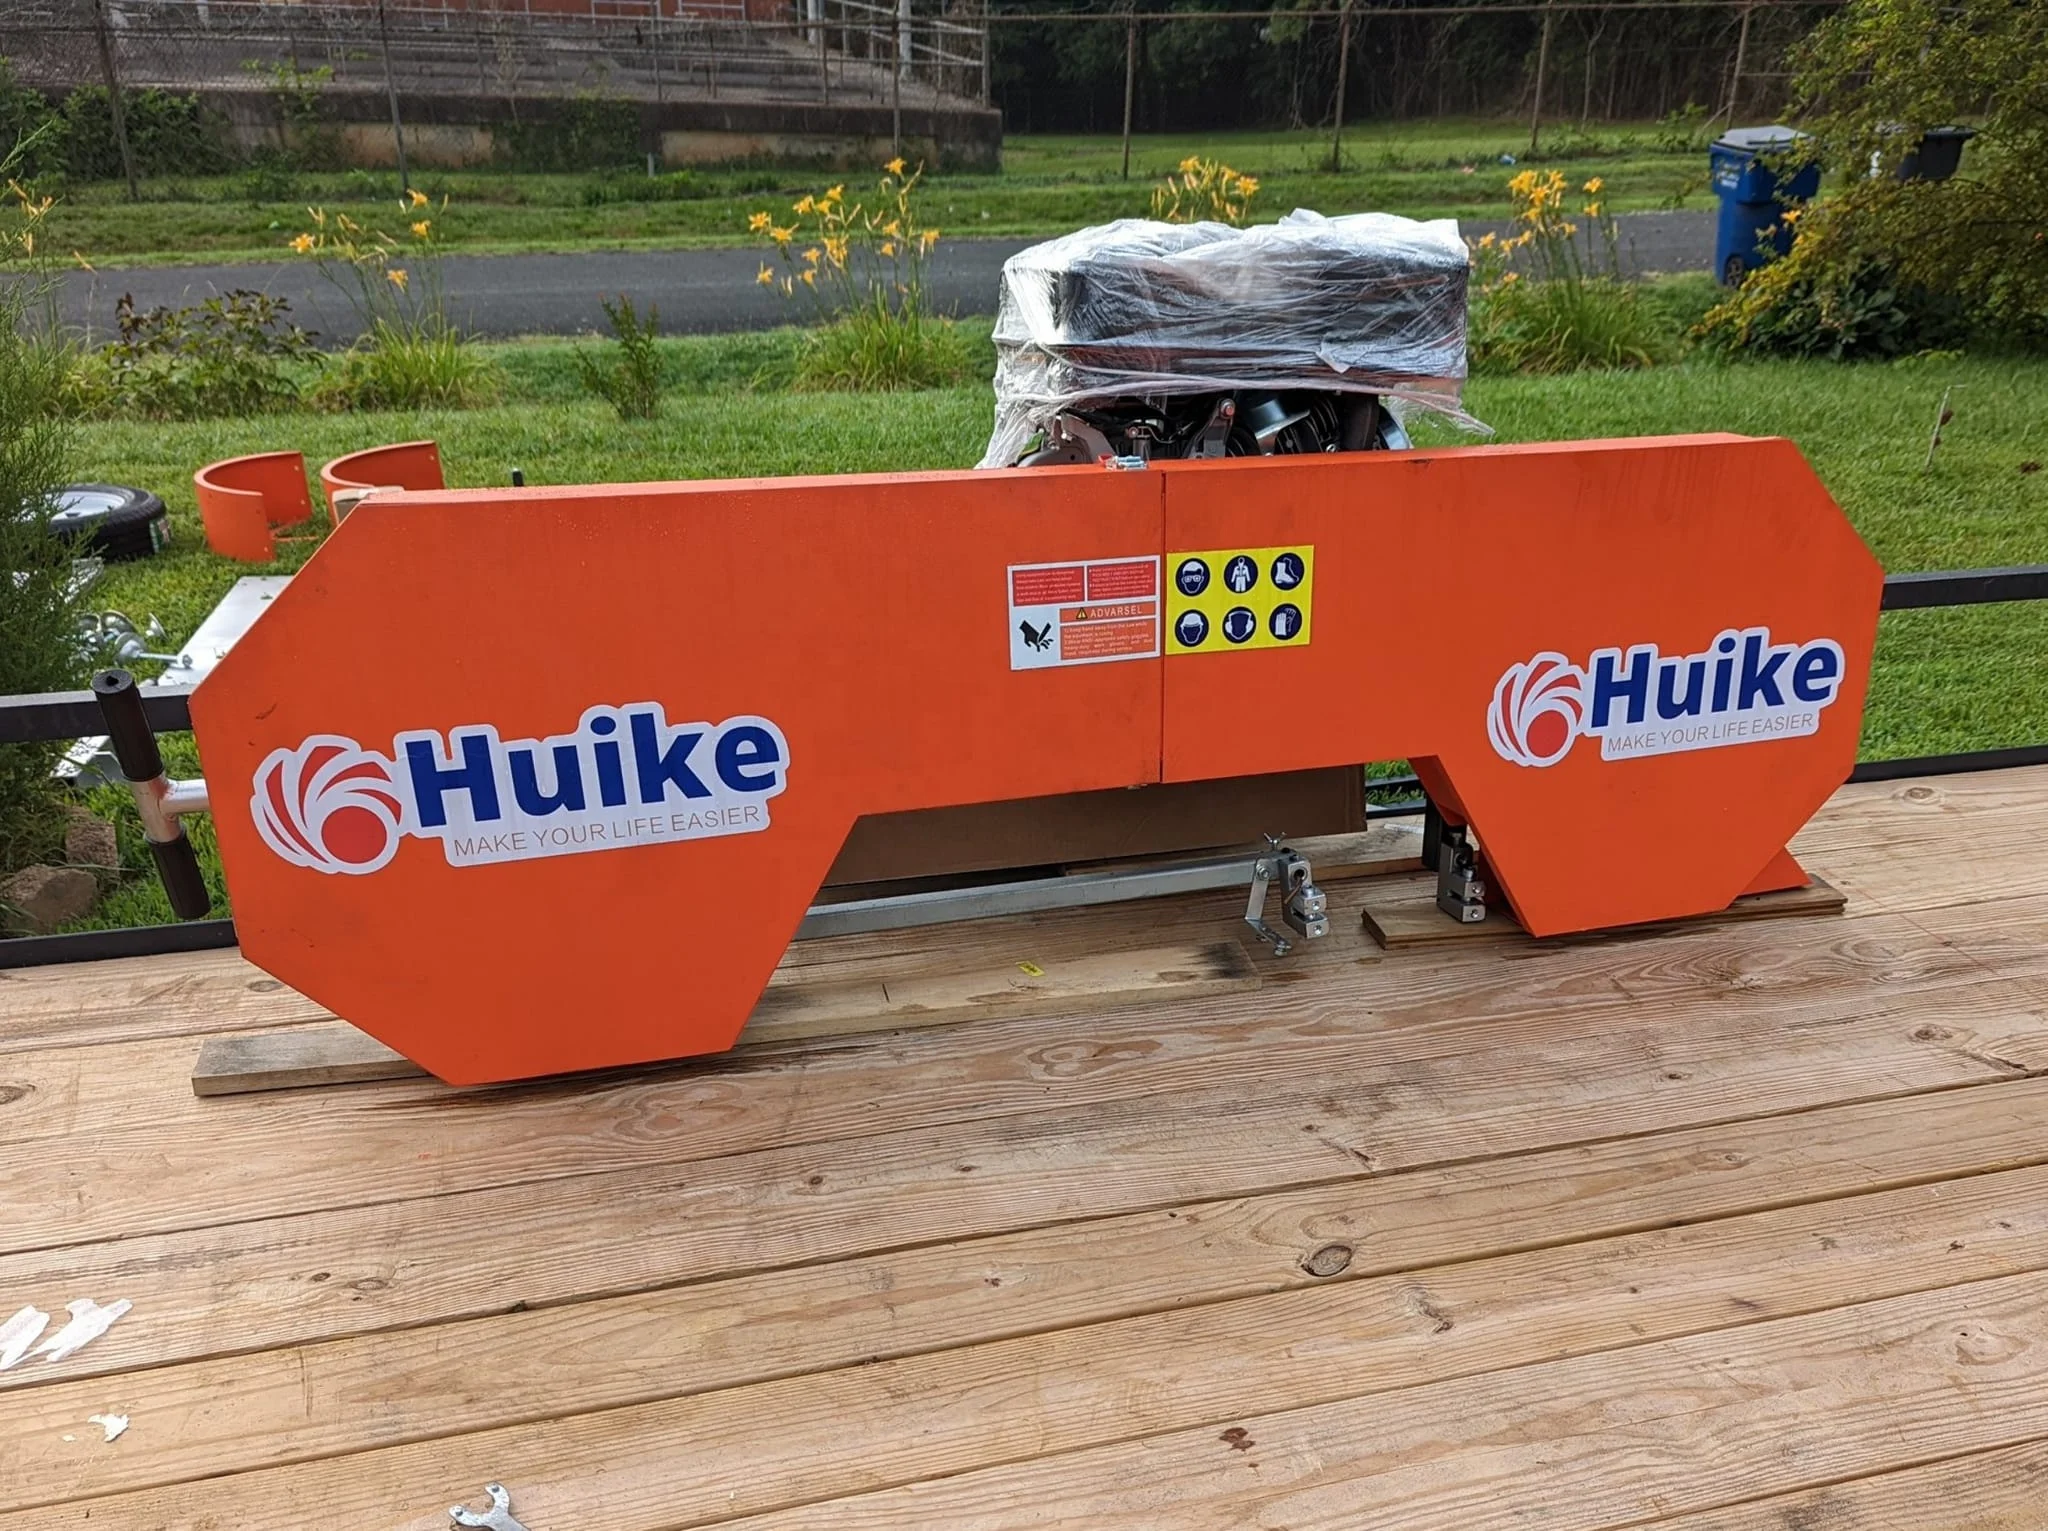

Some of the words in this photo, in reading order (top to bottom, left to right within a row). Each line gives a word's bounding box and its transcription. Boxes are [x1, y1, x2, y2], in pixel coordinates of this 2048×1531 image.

[1090, 605, 1142, 618] ADVARSEL
[1591, 635, 1837, 728] Huike
[1608, 734, 1655, 753] MAKE
[1661, 728, 1709, 745] YOUR
[1713, 721, 1747, 739] LIFE
[1752, 713, 1813, 734] EASIER
[405, 712, 780, 828] Huike
[453, 832, 527, 857] MAKE
[533, 824, 607, 848] YOUR
[613, 816, 665, 838] LIFE
[672, 805, 760, 831] EASIER
